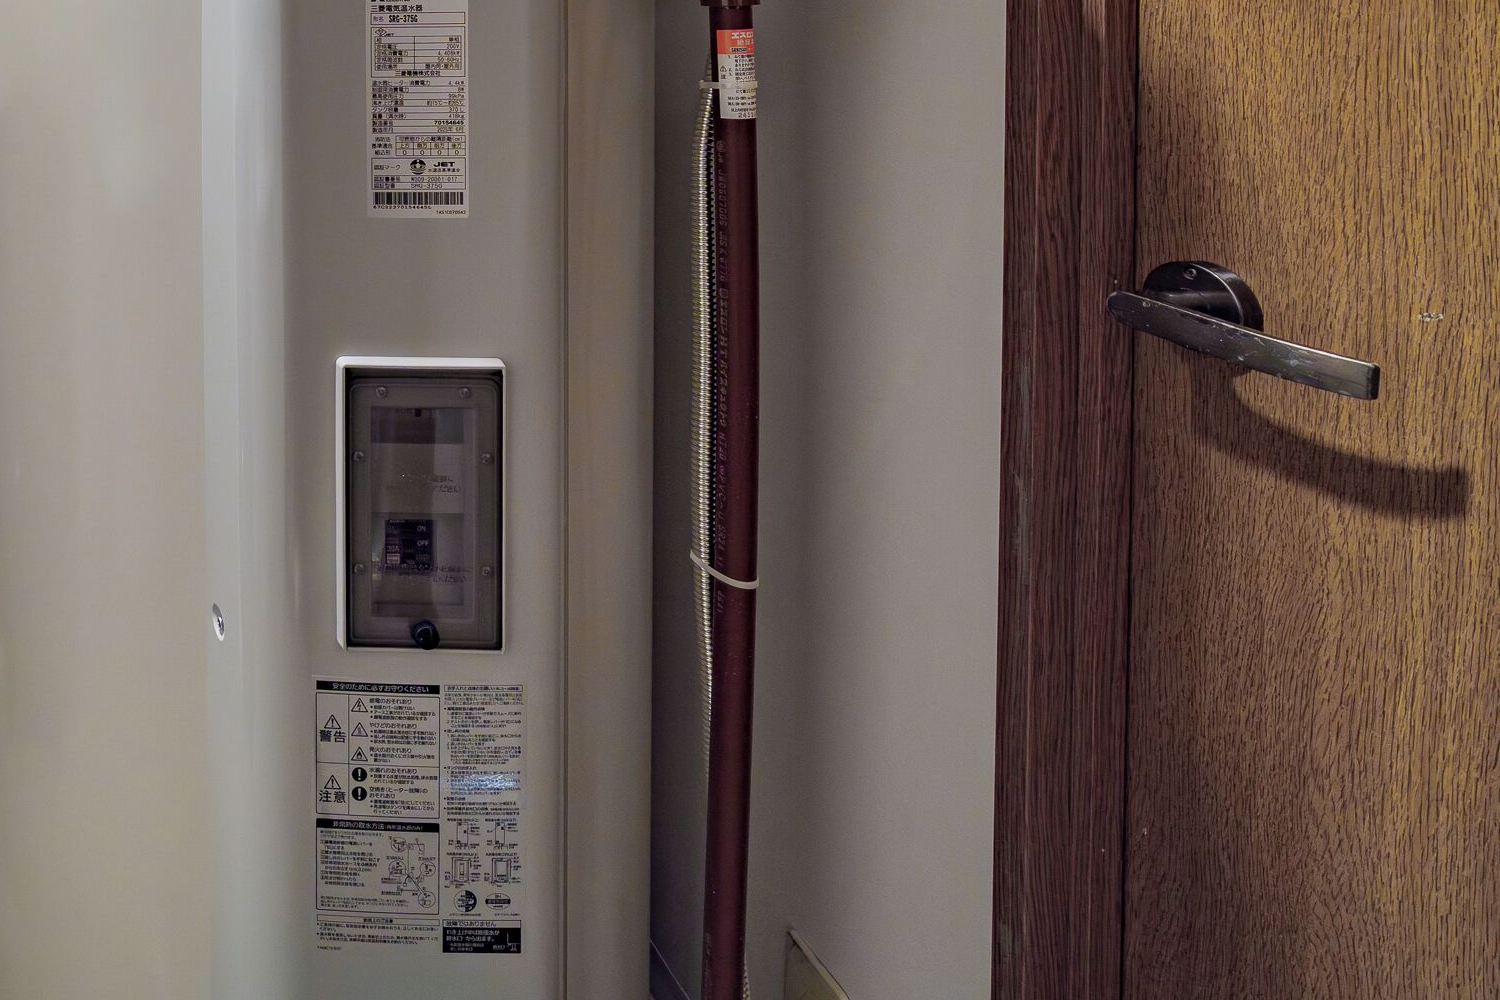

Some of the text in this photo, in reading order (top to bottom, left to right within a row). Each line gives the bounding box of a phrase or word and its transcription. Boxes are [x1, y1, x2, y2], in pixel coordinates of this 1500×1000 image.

[332, 682, 430, 693] 安全のために必ずお守りください
[319, 729, 346, 743] 警告
[369, 767, 418, 775] 水漏れのおそれあり
[319, 791, 346, 804] 注意
